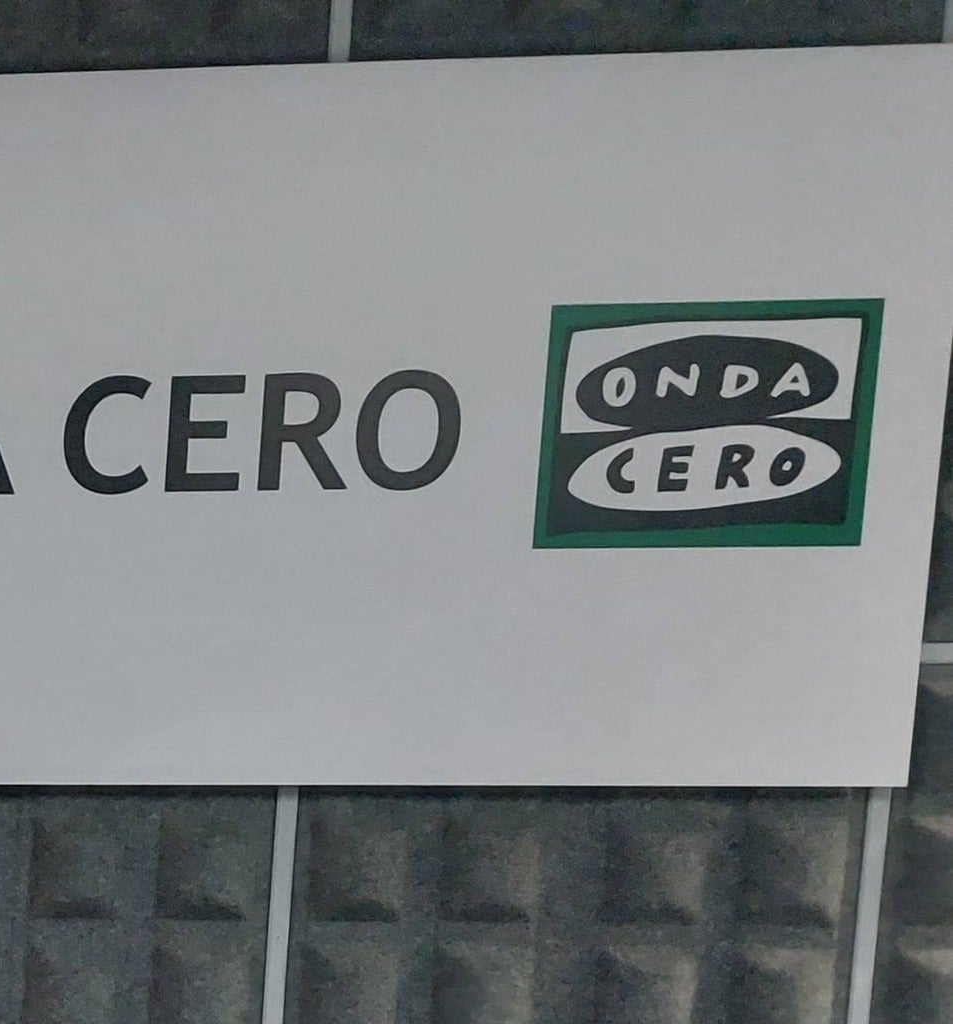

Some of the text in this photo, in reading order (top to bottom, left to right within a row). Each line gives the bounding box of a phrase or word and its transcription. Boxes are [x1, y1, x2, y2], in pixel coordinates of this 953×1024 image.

[602, 362, 811, 408] ONDA
[63, 369, 462, 496] CERO
[606, 444, 806, 494] CERO
